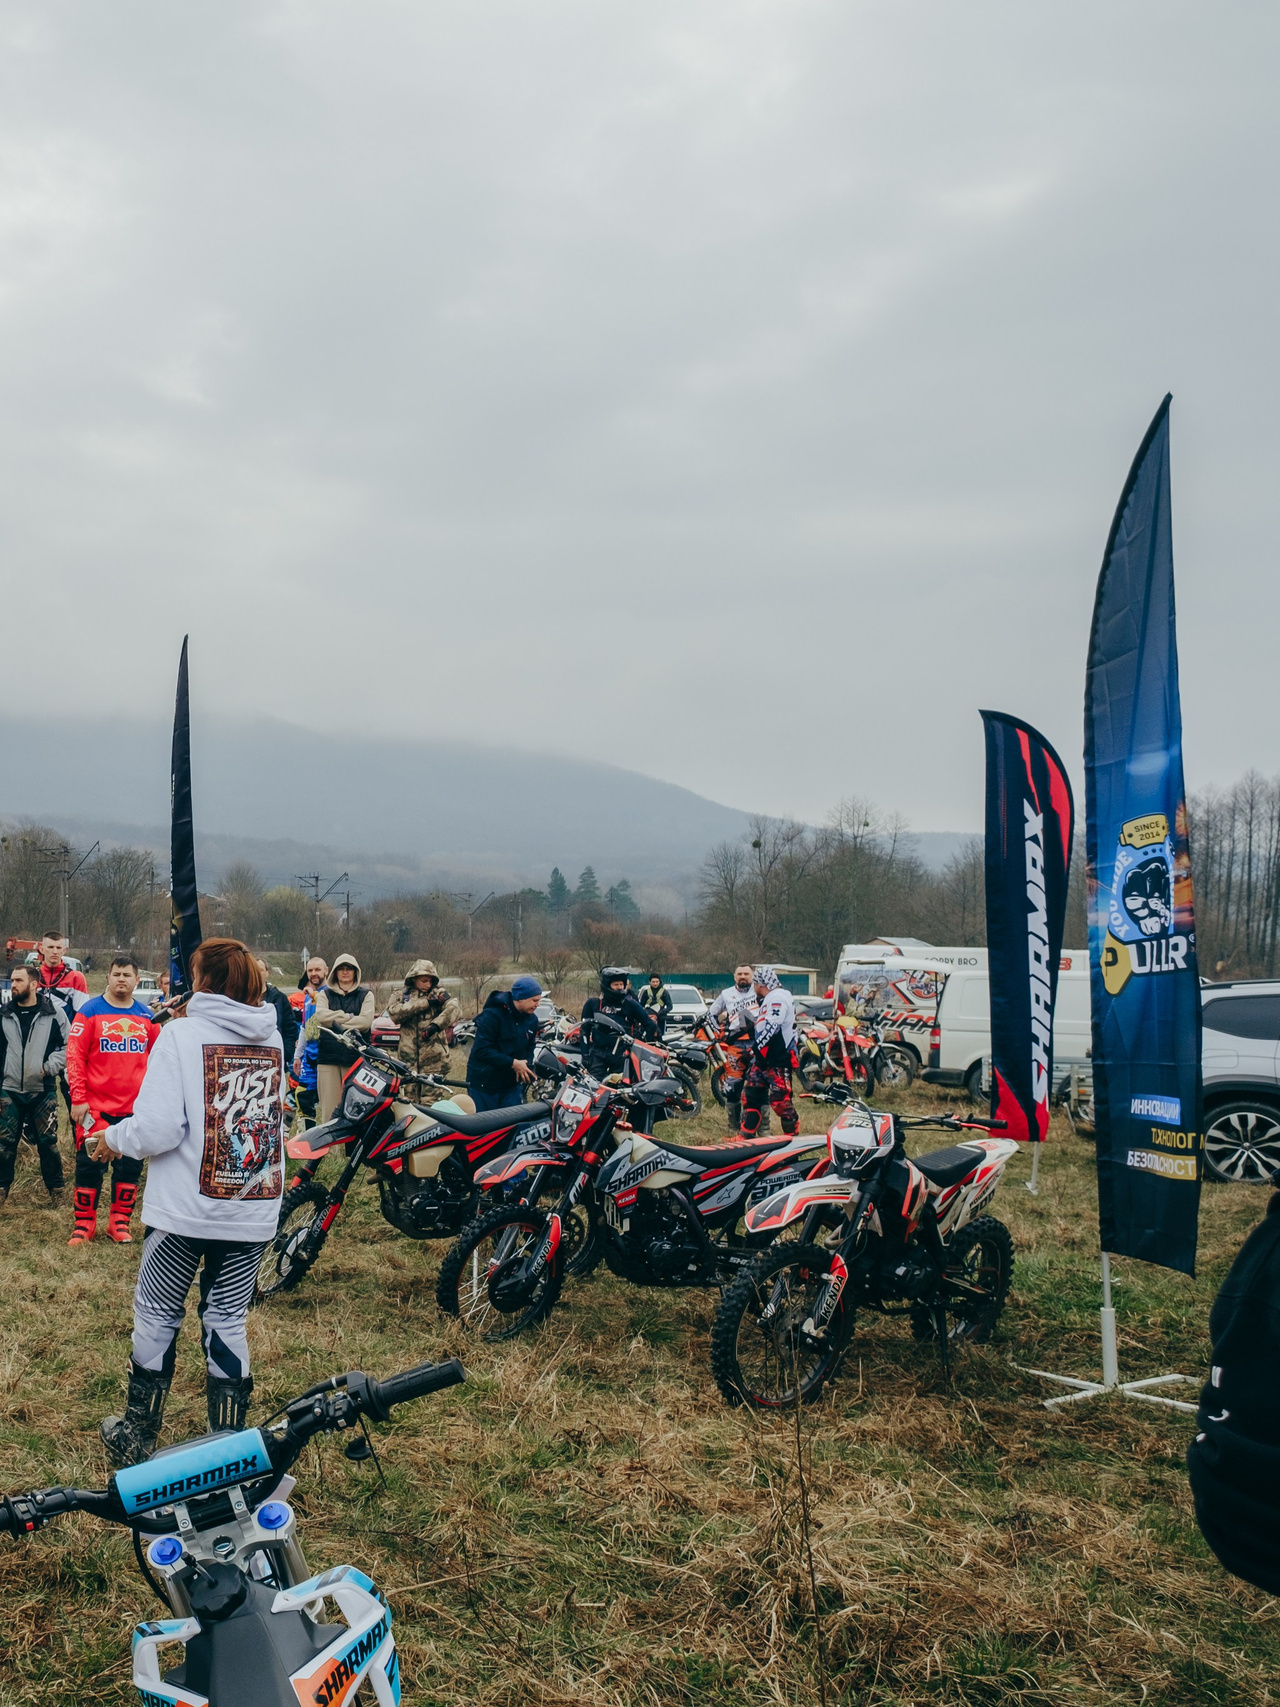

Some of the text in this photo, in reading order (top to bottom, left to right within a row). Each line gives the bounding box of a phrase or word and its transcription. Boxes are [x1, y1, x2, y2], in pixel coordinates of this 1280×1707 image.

[1134, 820, 1161, 832] SINCE
[1139, 831, 1161, 841] 2014
[958, 957, 978, 966] BRO
[1023, 797, 1050, 1109] SHARMAX
[100, 1038, 127, 1053] Red
[213, 1067, 280, 1112] JUST
[362, 1071, 378, 1088] 111
[571, 1093, 577, 1103] 1
[1130, 1098, 1179, 1120] ИННОВАЦИИ
[387, 1126, 443, 1159] SHARMAX
[215, 1170, 243, 1179] FUELLED
[606, 1149, 674, 1194] SHARMAX
[1127, 1150, 1197, 1176] БЕЗОПАСНОСТ
[619, 1193, 636, 1205] KENDA
[531, 1239, 554, 1276] KENDA
[820, 1274, 845, 1320] KENDA
[132, 1454, 258, 1508] SHARMAX
[312, 1615, 389, 1707] SHARMAX
